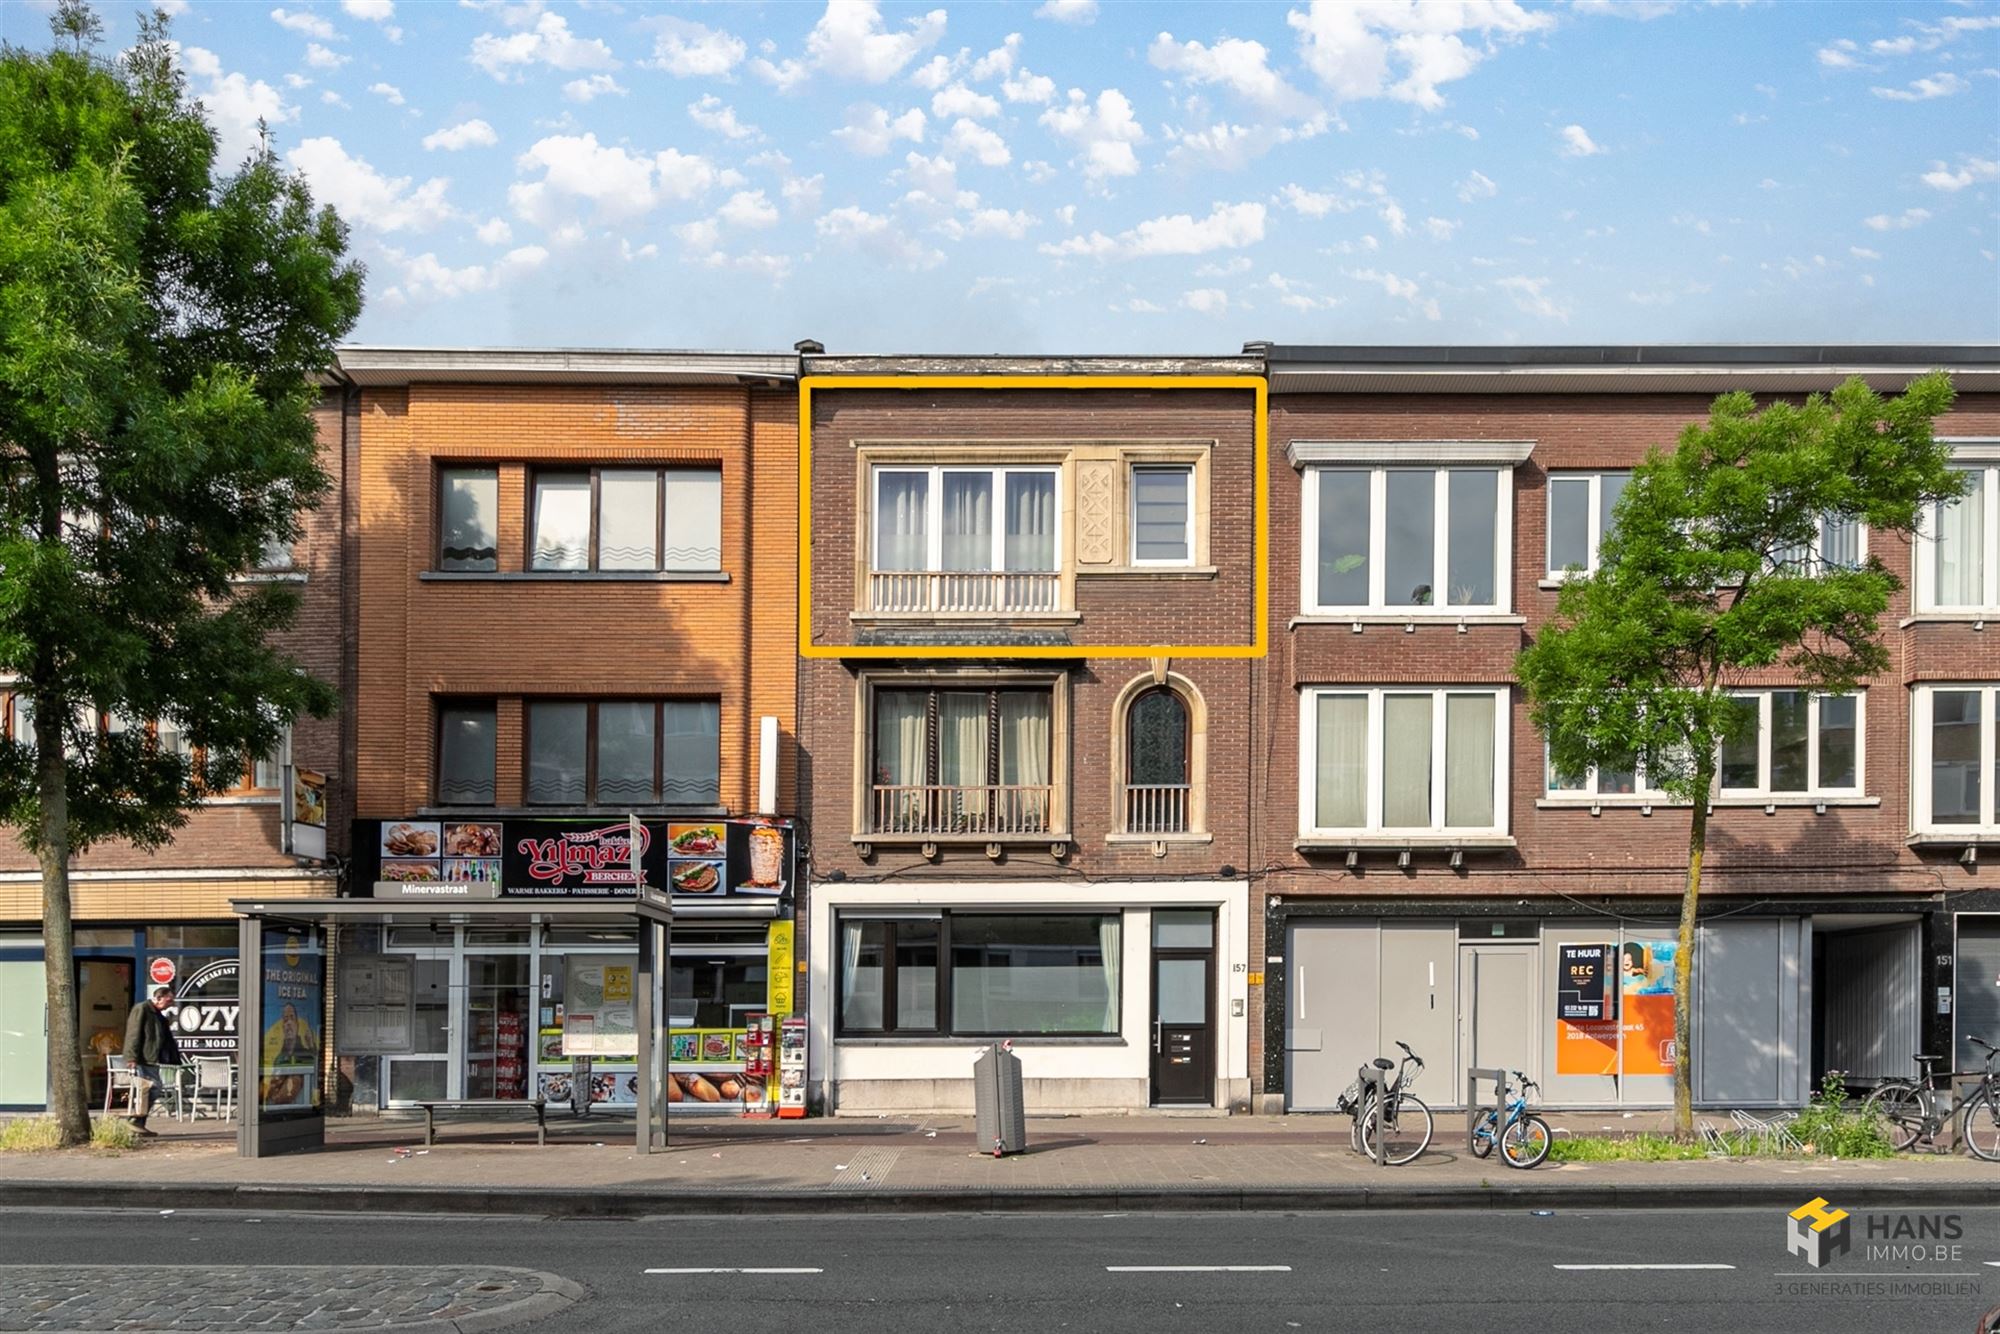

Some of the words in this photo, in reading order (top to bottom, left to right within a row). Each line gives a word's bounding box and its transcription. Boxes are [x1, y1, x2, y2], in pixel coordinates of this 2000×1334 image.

[402, 884, 468, 894] Minervastraat
[534, 887, 568, 895] BAKKERIJ
[1566, 949, 1576, 958] TE
[1577, 949, 1601, 958] HUUR
[1936, 955, 1952, 965] 151
[1232, 964, 1246, 972] 157
[1570, 965, 1594, 975] REC
[196, 967, 236, 988] BREAKFAST
[265, 968, 280, 981] THE
[282, 970, 319, 984] ORIGINAL
[278, 985, 291, 998] ICE
[293, 986, 307, 998] TEA
[1566, 1032, 1583, 1040] 2018
[177, 1039, 199, 1048] THE
[205, 1039, 236, 1048] MOOD
